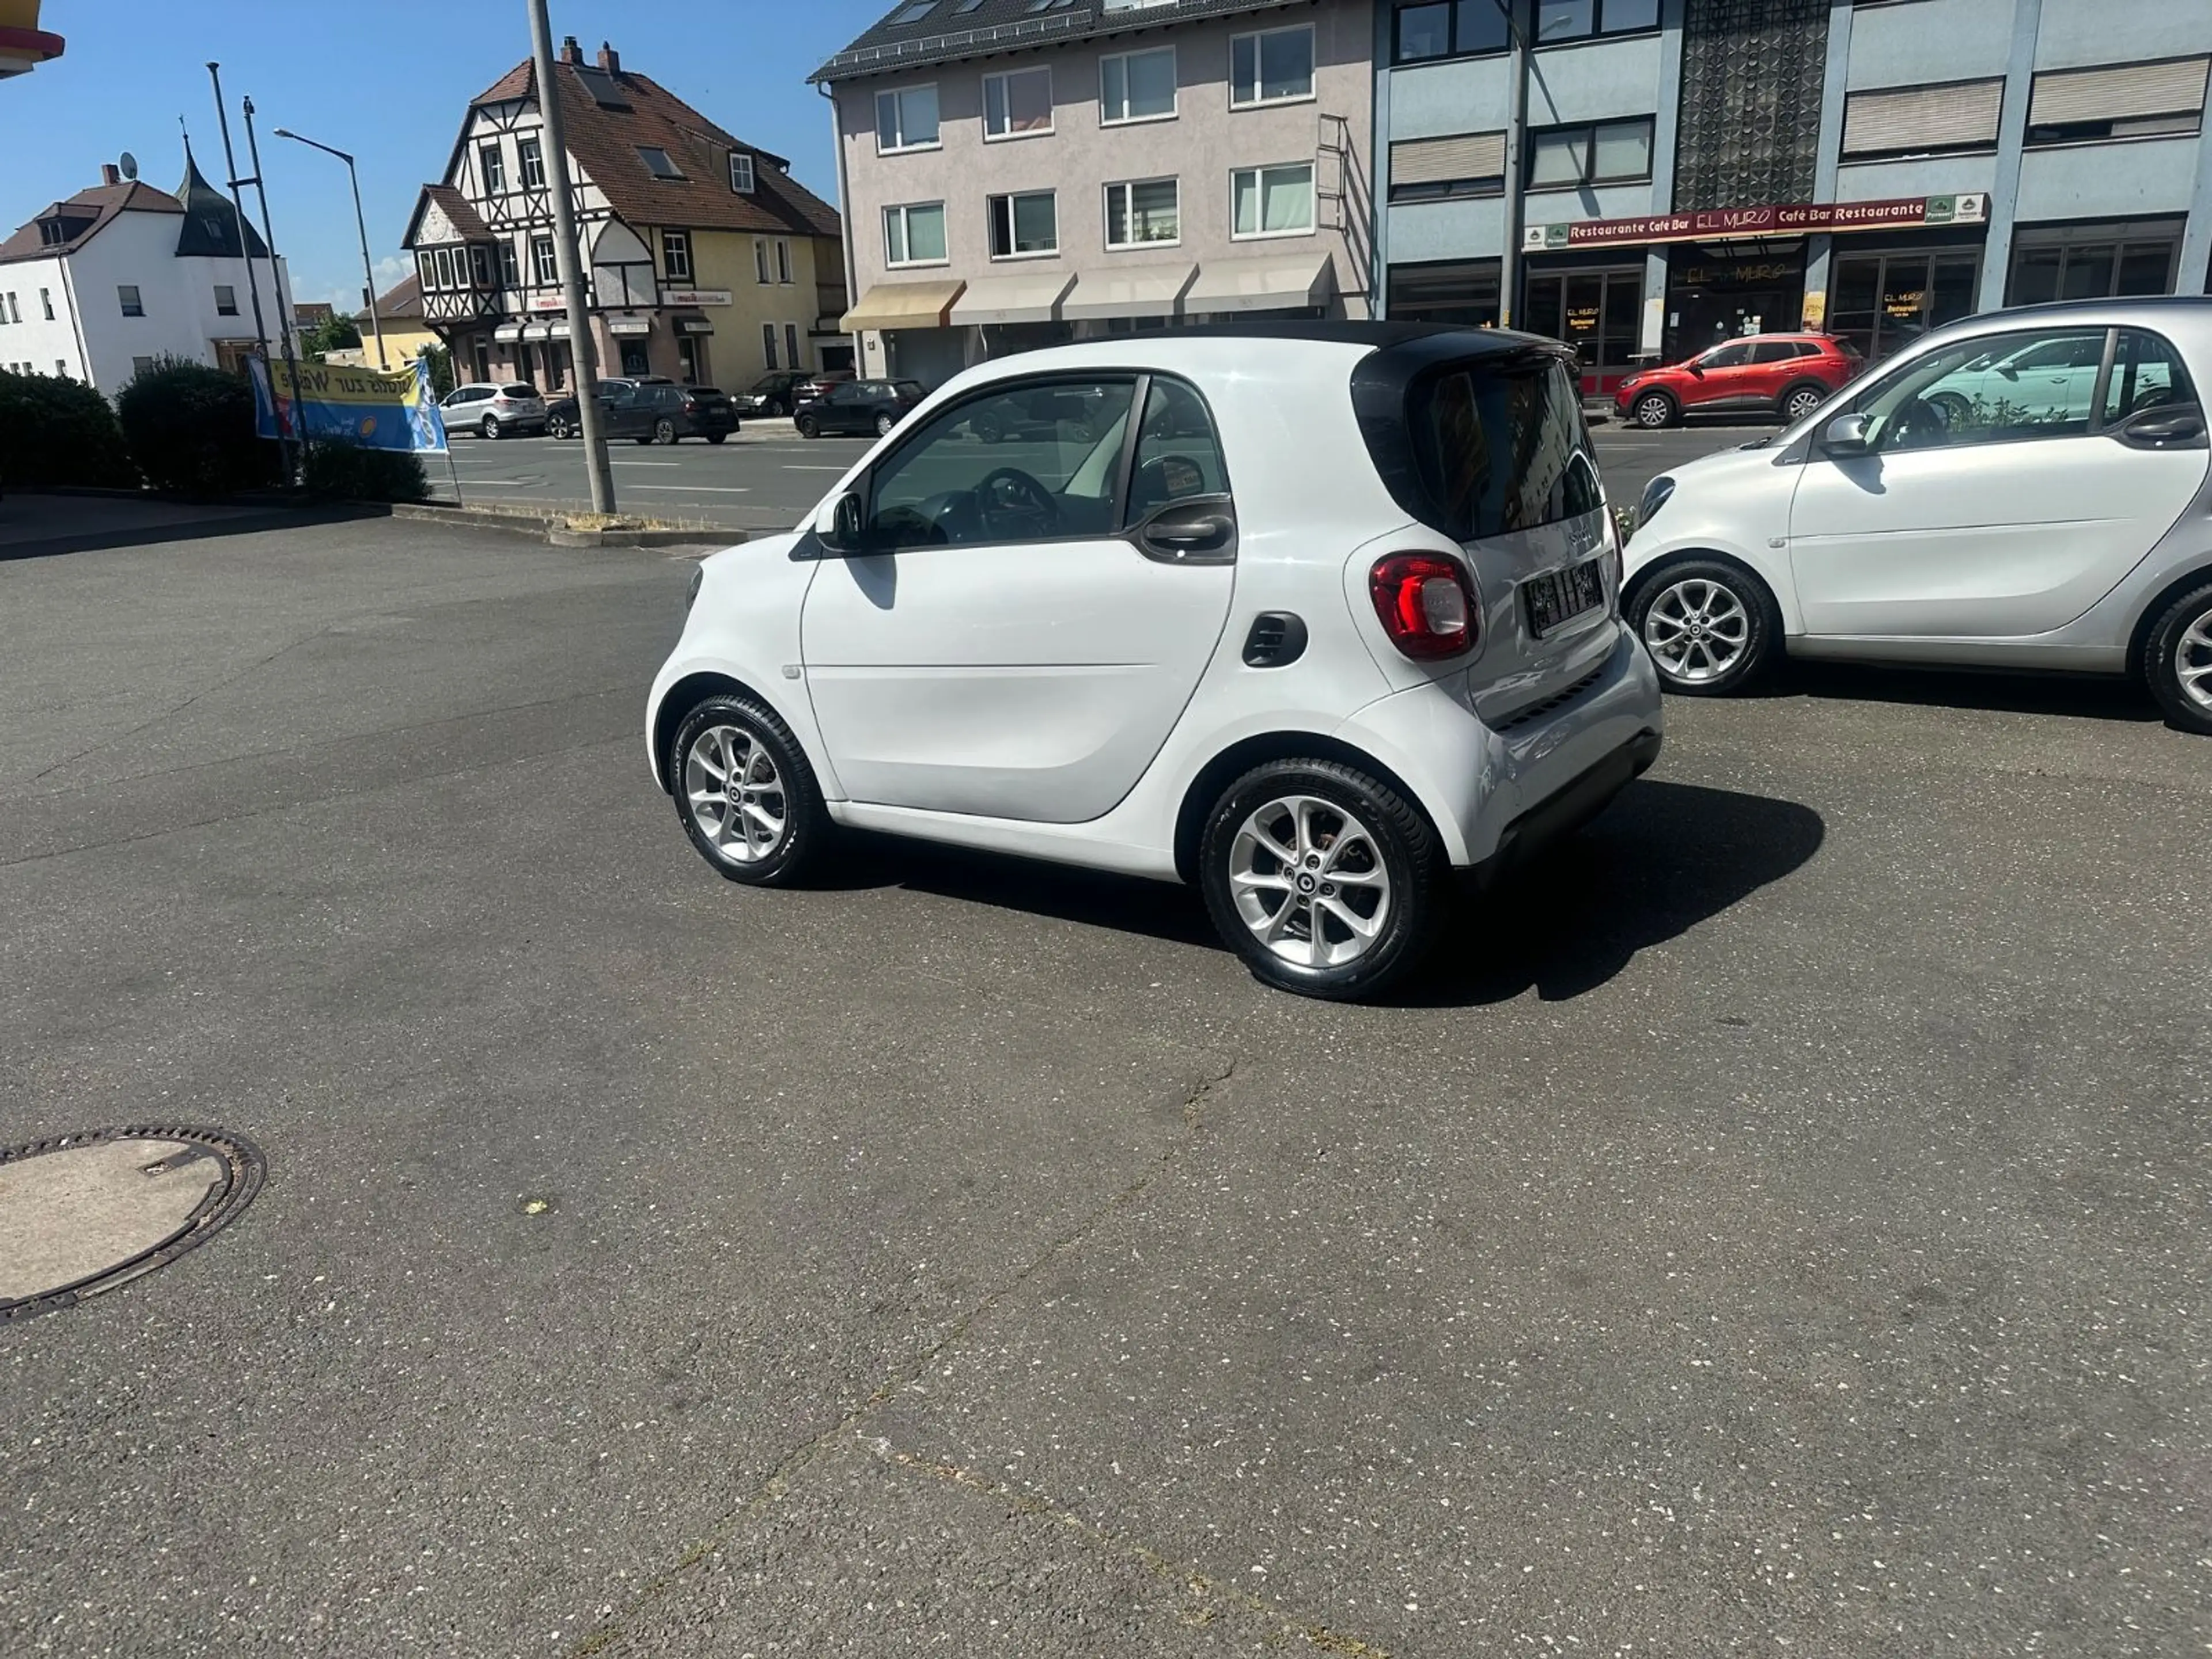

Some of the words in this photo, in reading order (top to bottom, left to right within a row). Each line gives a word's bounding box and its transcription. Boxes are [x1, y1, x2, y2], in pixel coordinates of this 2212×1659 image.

[1570, 222, 1645, 238] Restaurante
[1649, 219, 1669, 232] Café
[1672, 219, 1690, 230] Bar
[1696, 213, 1719, 229] EL
[1724, 209, 1771, 228] MURO
[1779, 210, 1805, 222] Café
[1809, 209, 1831, 221] Bar
[1835, 203, 1923, 220] Restaurante
